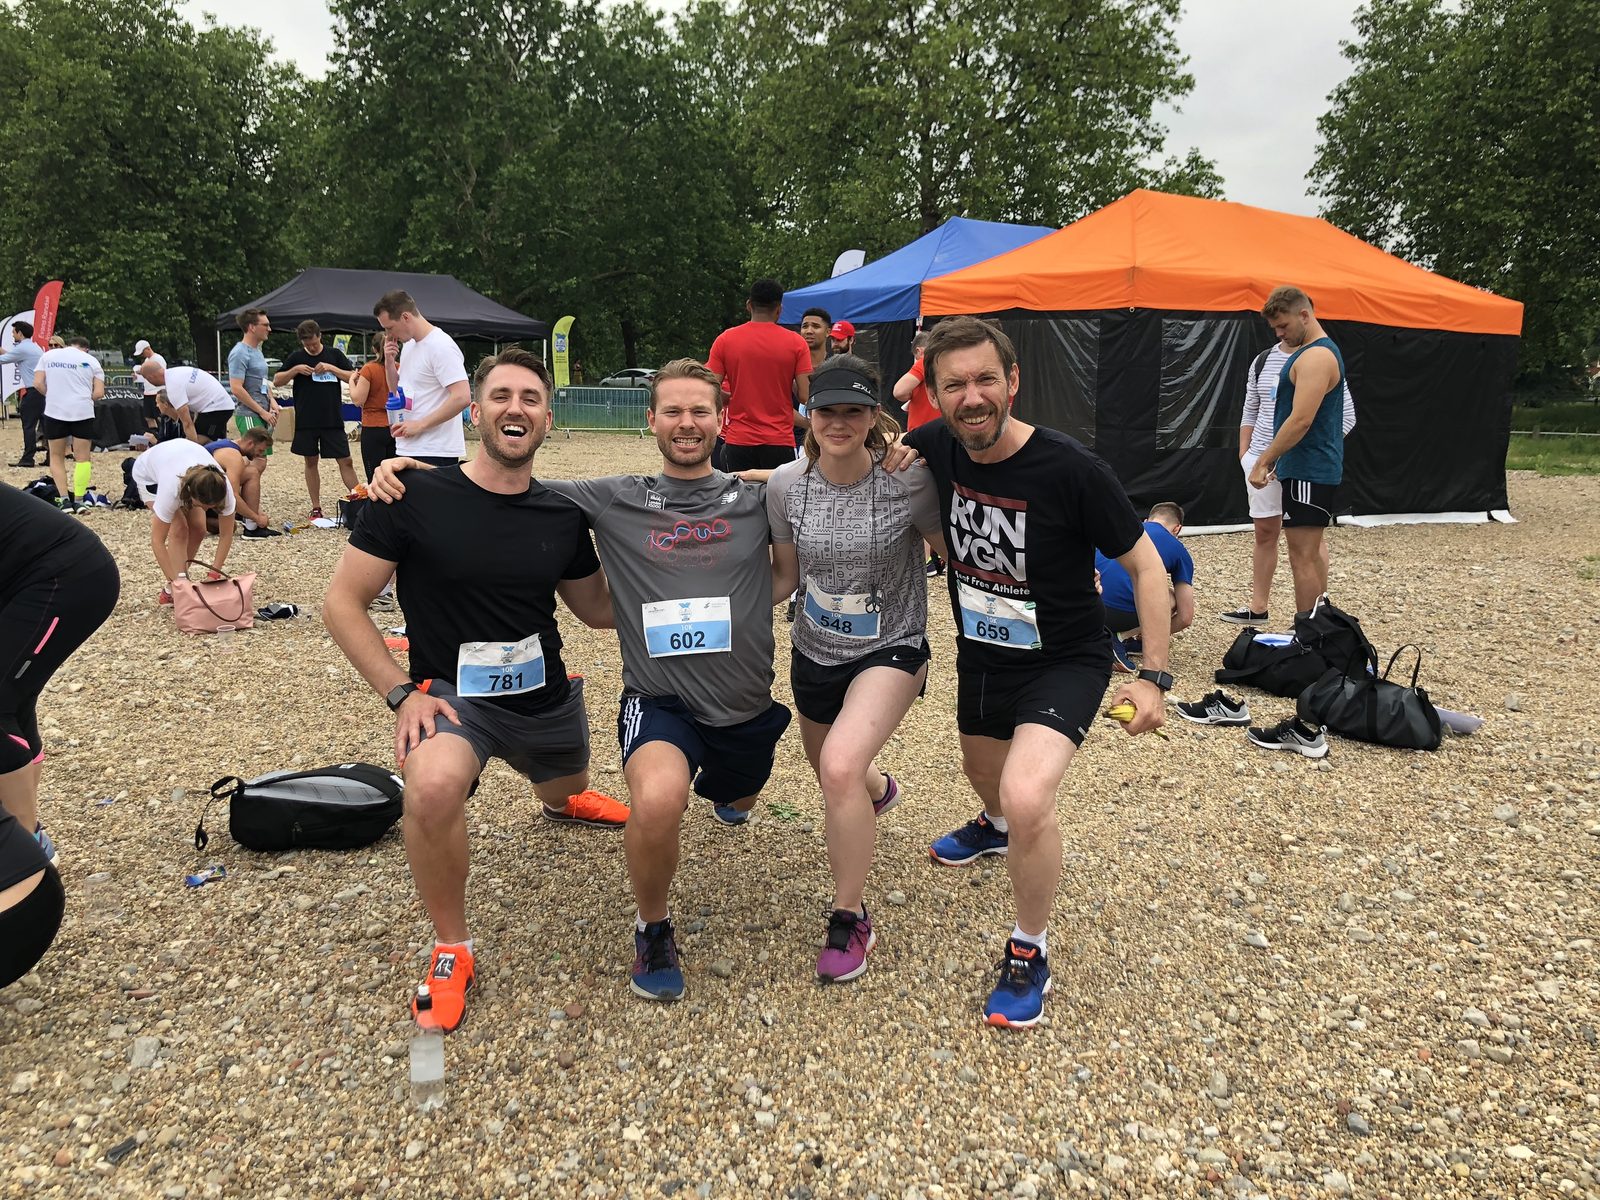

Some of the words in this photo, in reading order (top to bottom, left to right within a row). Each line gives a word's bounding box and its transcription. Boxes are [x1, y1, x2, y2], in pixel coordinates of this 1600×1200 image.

[47, 362, 77, 370] LOGICOR
[950, 489, 1027, 549] RUN
[950, 526, 1027, 582] VGN
[971, 576, 990, 590] Free
[992, 583, 1031, 596] Athlete
[820, 614, 853, 633] 548
[976, 620, 1010, 641] 659
[670, 631, 706, 650] 602
[502, 665, 515, 673] 10K
[488, 672, 523, 691] 781
